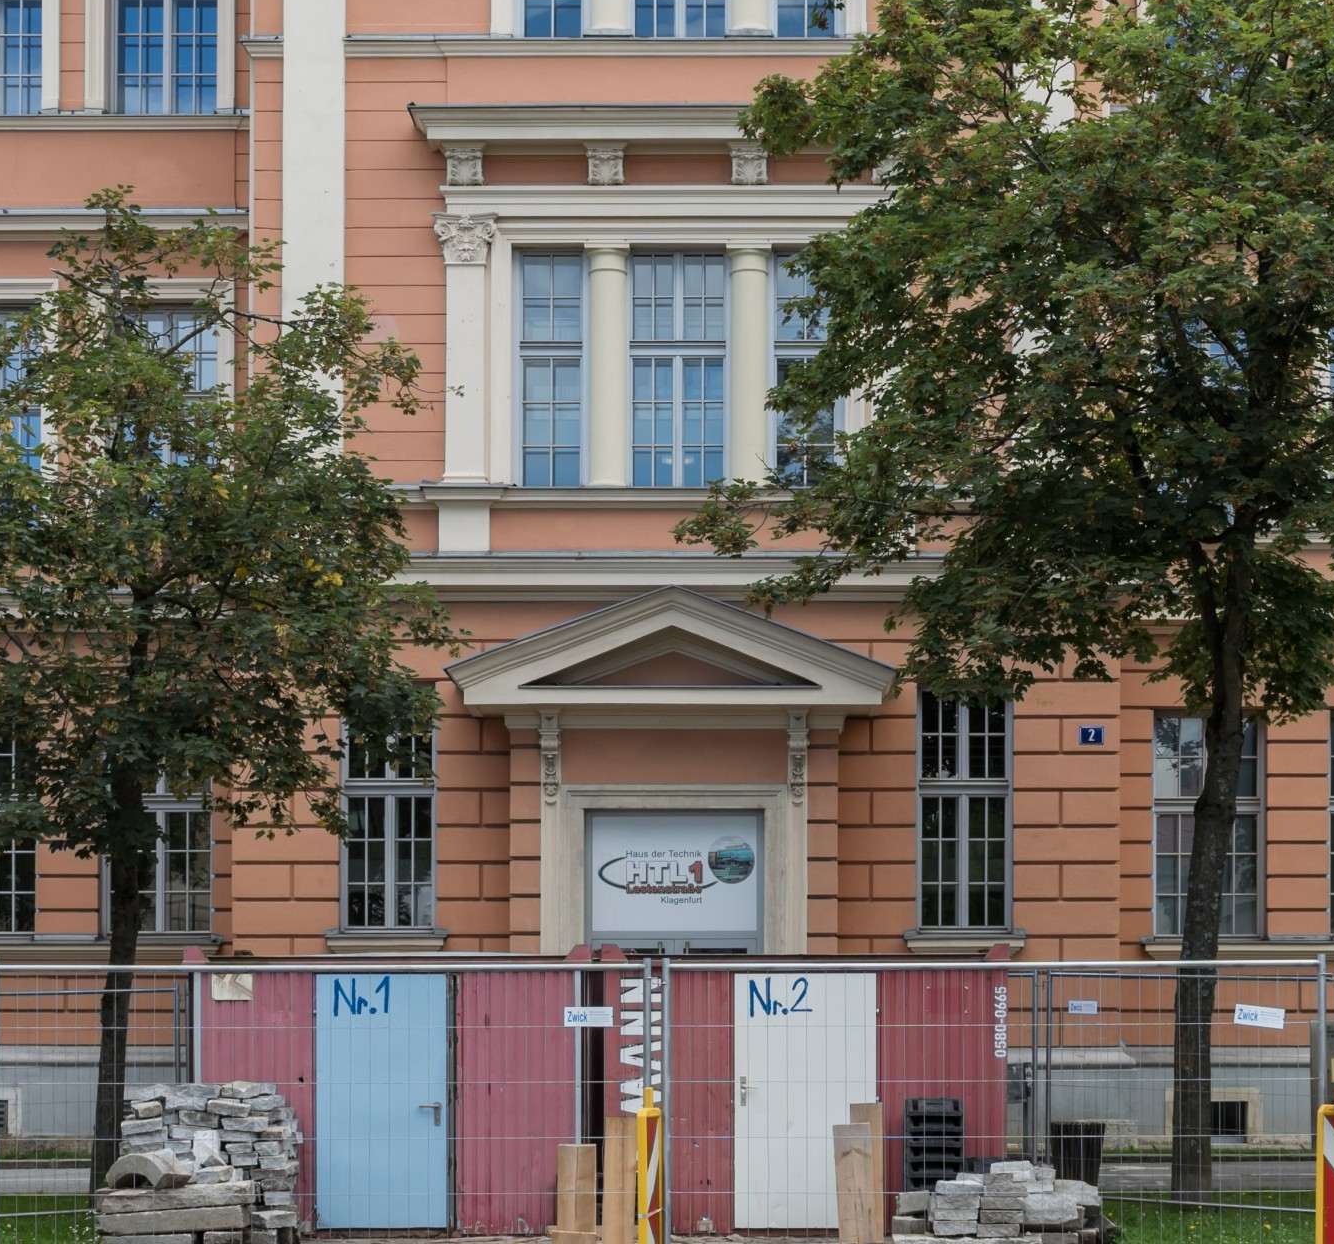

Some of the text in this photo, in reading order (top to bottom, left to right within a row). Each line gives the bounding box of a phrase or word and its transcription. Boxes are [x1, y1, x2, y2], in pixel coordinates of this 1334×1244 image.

[1088, 728, 1096, 742] 2
[625, 850, 702, 858] Haus der Technik
[625, 860, 703, 884] HTL1
[625, 883, 703, 894] Lastenstraße
[660, 896, 702, 905] Klagenfurt
[567, 1011, 588, 1023] Zwick
[1237, 1008, 1259, 1022] Zwick
[994, 986, 1007, 1058] 0580-0665
